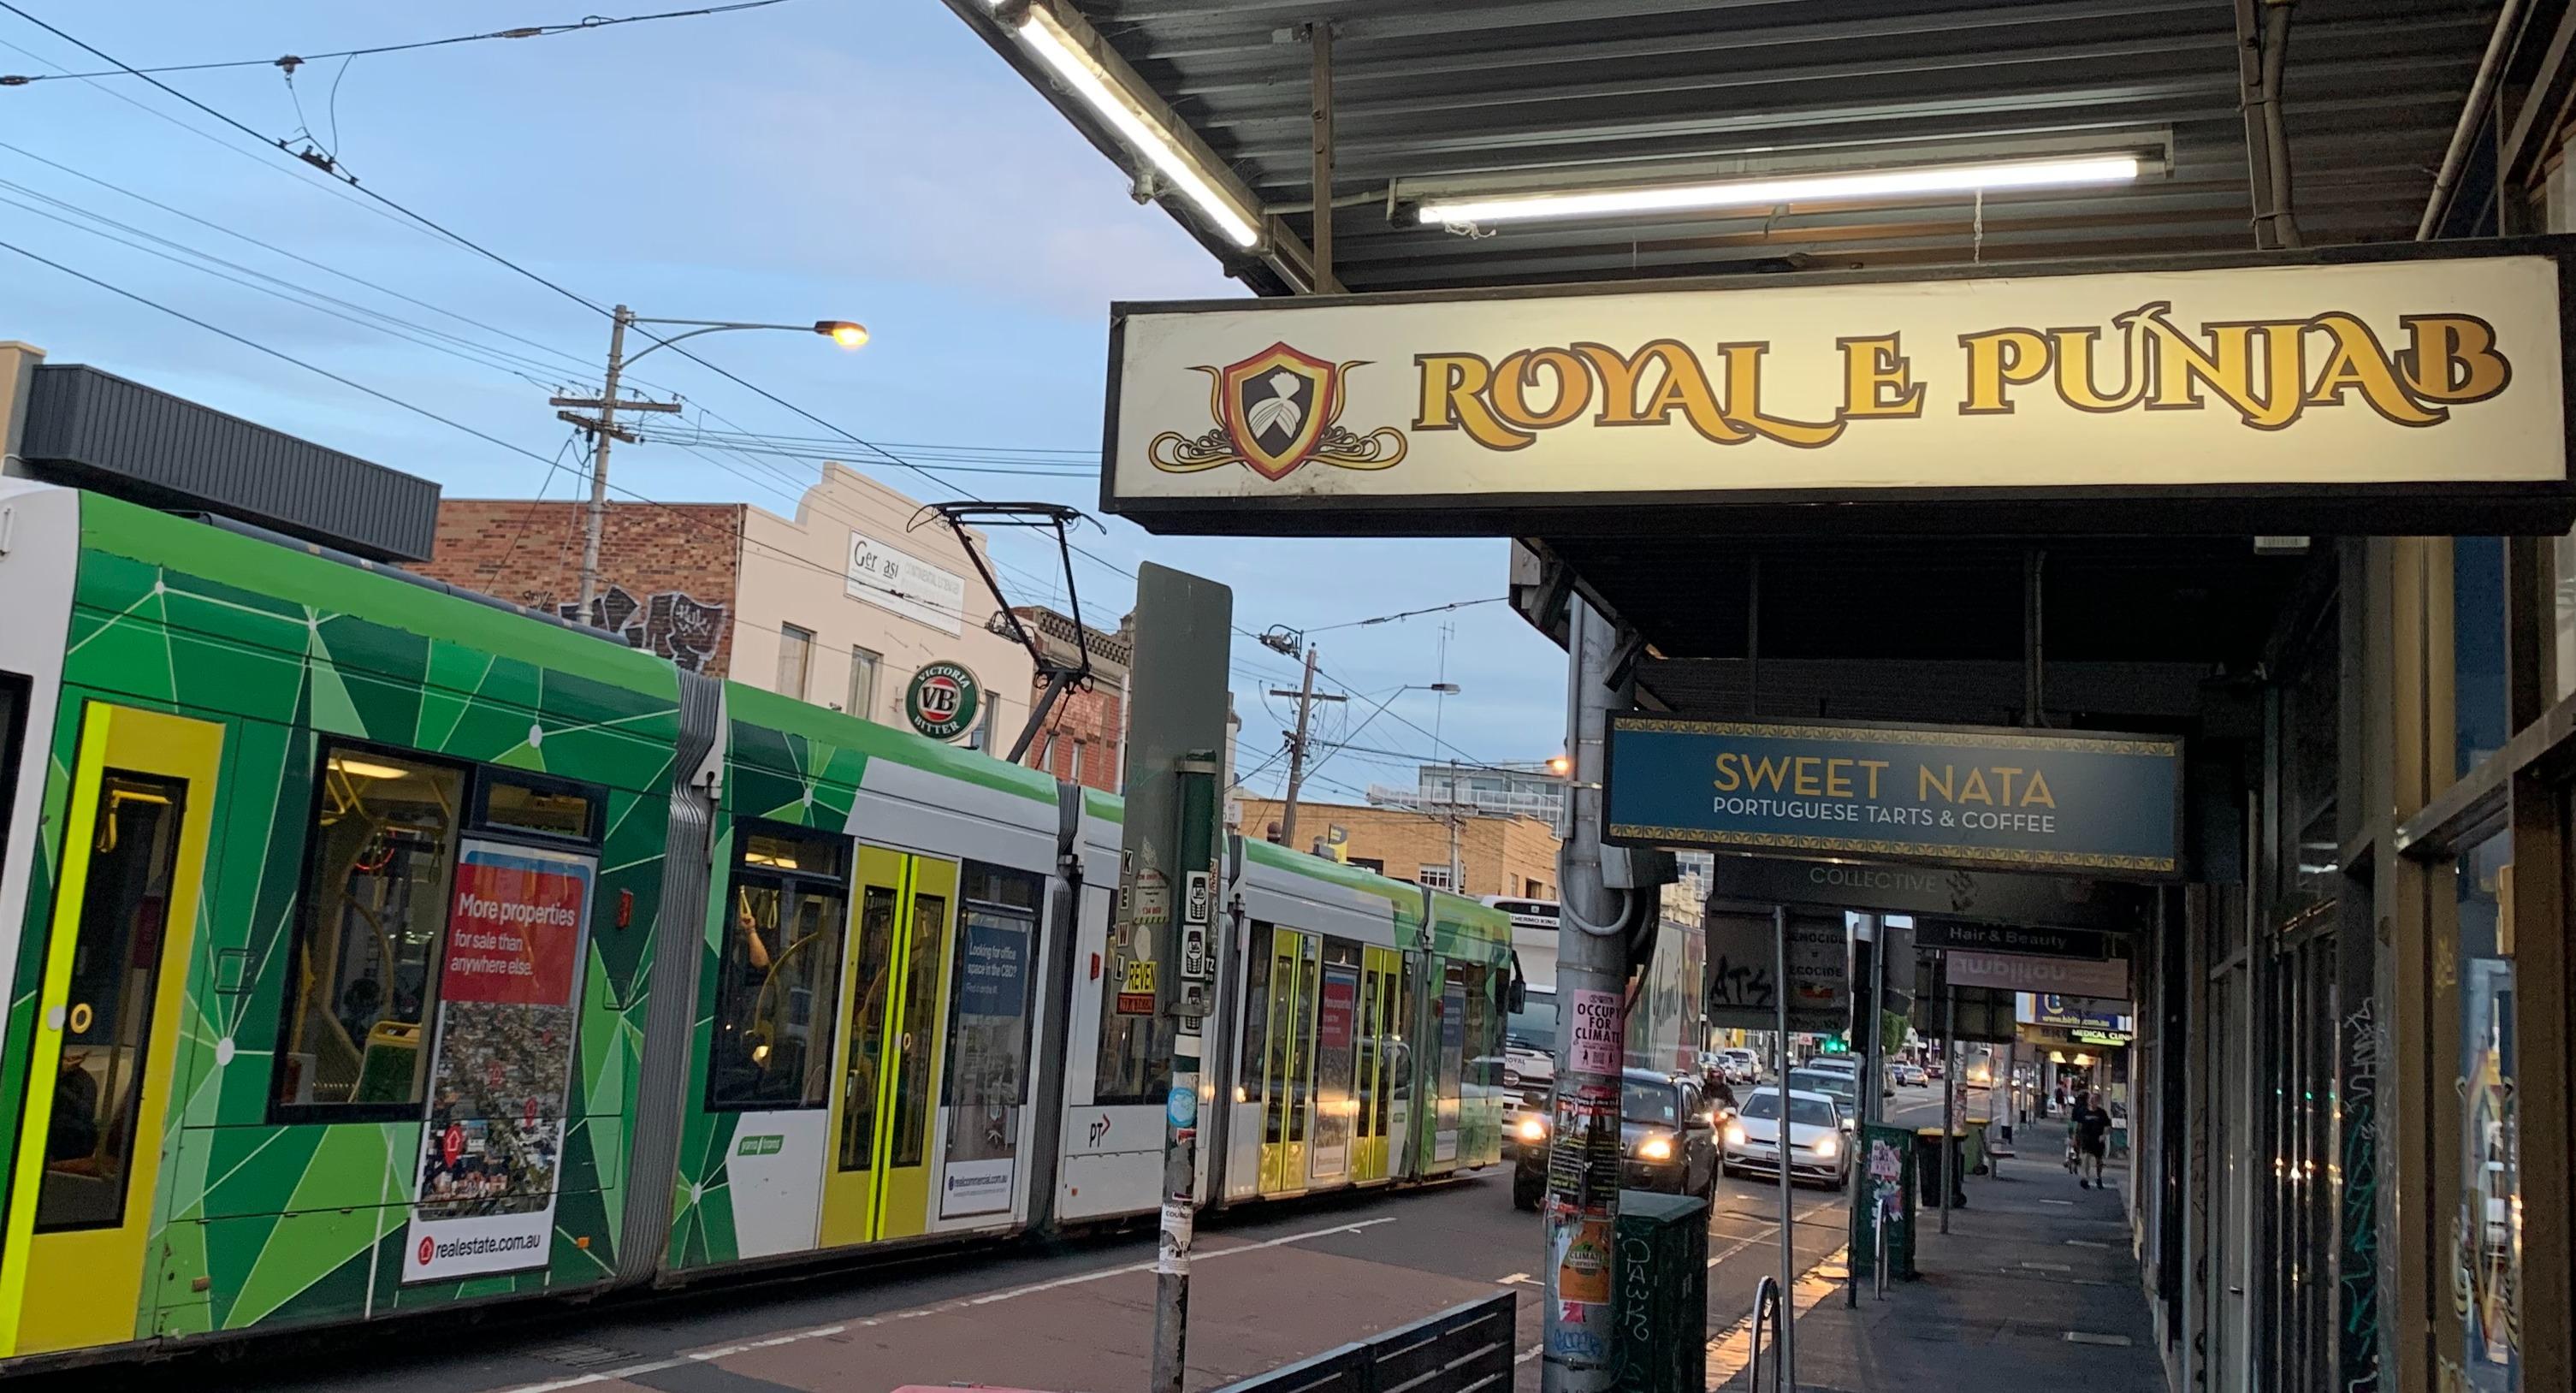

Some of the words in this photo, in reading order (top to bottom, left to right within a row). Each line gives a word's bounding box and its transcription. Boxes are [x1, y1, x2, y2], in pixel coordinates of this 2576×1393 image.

[1958, 300, 2513, 430] PUNJAB
[917, 666, 969, 689] VICTORIA
[922, 686, 954, 711] VB
[914, 715, 961, 735] BITTER
[1713, 753, 1889, 800] SWEET
[1917, 763, 2057, 809] NATA
[1713, 796, 1859, 822] PORTUGUESE
[1864, 804, 1933, 827] TARTS
[1939, 809, 1954, 828] &
[1962, 810, 2055, 833] COFFEE
[1809, 867, 1936, 893] COLLECTIVE
[459, 892, 499, 918] More
[500, 902, 575, 927] properties
[1511, 916, 1539, 924] THERMO
[455, 929, 472, 947] for
[473, 932, 496, 950] sale
[498, 934, 523, 951] than
[1950, 926, 1985, 942] Hair
[1986, 929, 2000, 943] &
[2005, 931, 2067, 949] Beauty
[969, 942, 991, 960] Looking
[450, 956, 506, 976] anywhere
[507, 960, 533, 975] else.
[1577, 1004, 1621, 1019] OCCUPY
[1590, 1017, 1611, 1030] FOR
[2071, 1028, 2107, 1040] MEDICAL
[435, 1234, 541, 1259] realestate.com.au
